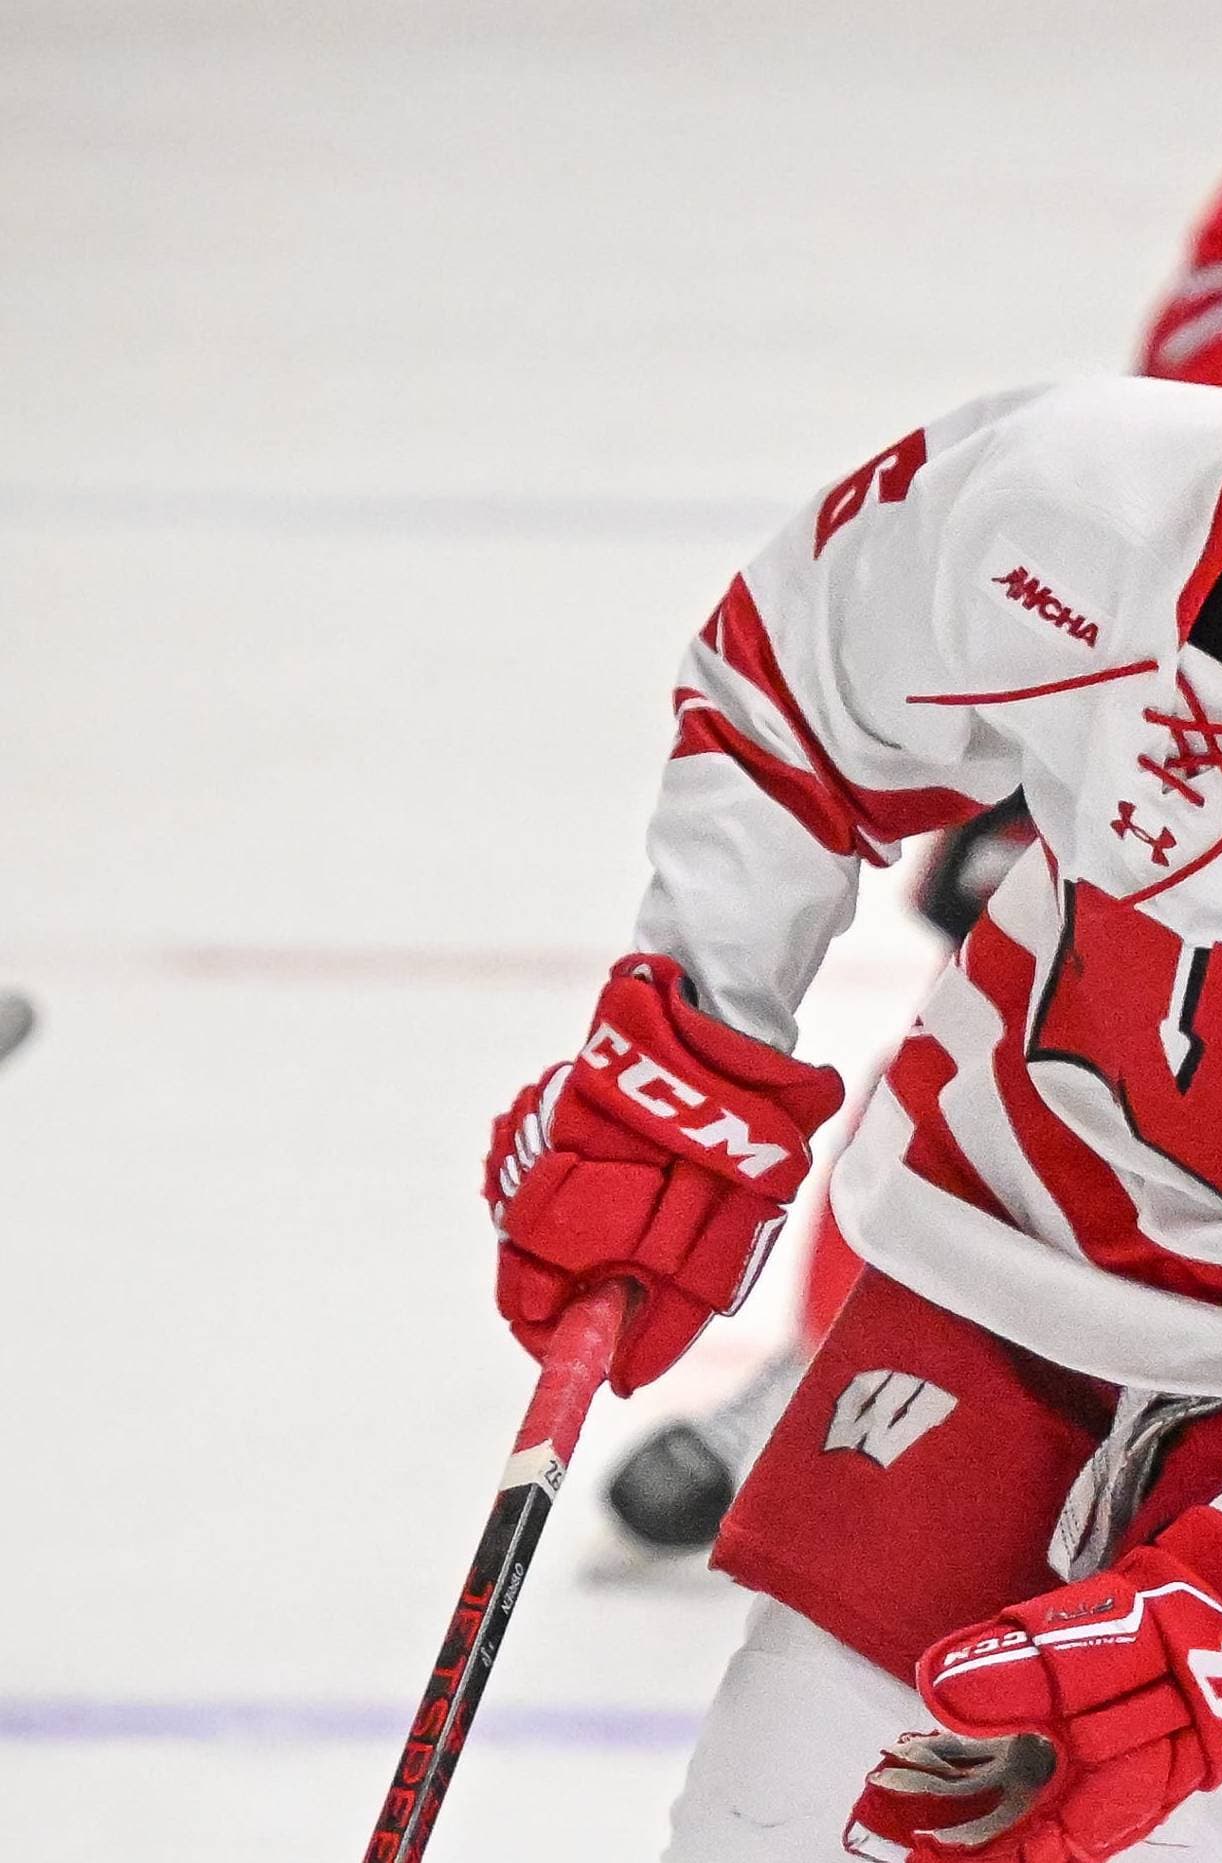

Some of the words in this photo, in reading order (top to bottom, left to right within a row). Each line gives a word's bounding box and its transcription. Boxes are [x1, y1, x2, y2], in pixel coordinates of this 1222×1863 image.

[991, 565, 1099, 648] WCHA
[580, 1021, 791, 1180] CCM
[823, 1368, 959, 1470] W
[544, 1459, 562, 1492] 26
